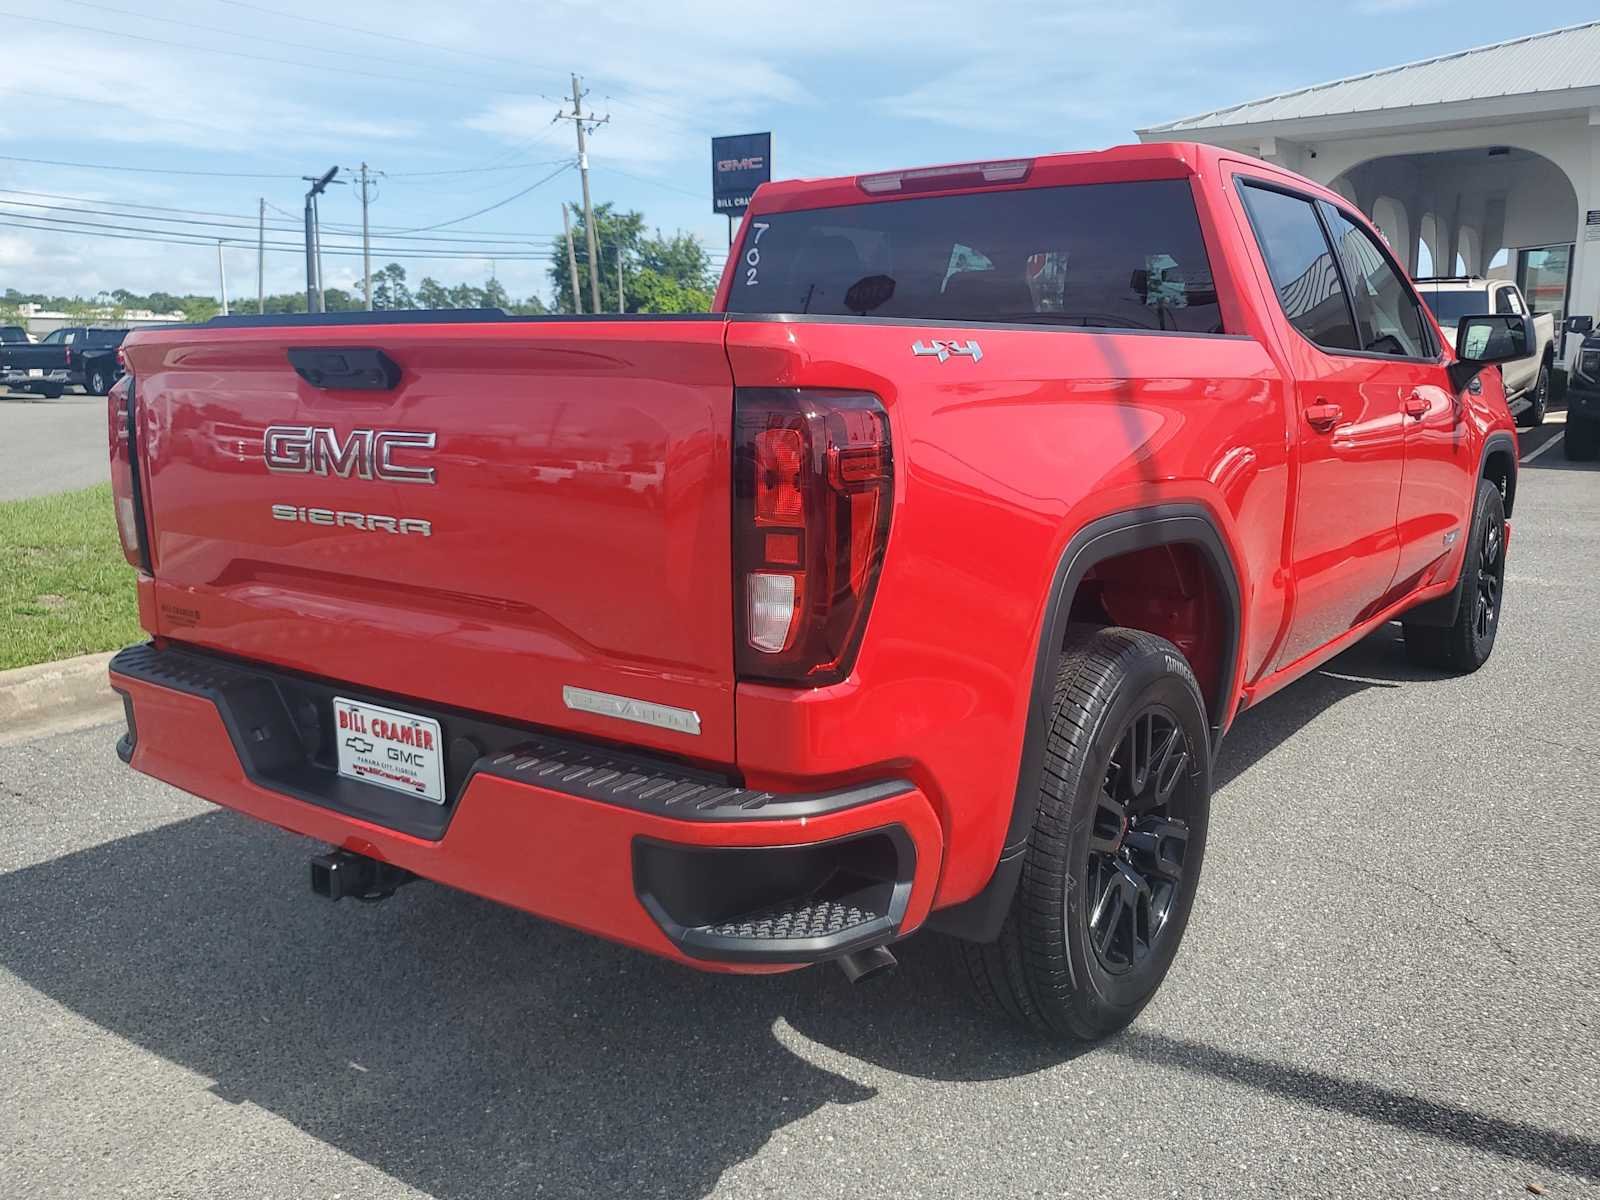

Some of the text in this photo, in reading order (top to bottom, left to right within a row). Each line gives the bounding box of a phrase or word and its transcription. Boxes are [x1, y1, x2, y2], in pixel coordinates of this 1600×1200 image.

[718, 157, 763, 171] GMC
[717, 198, 733, 208] BILL
[746, 223, 769, 285] 702
[264, 426, 436, 484] GMC
[272, 504, 432, 537] SIERRA
[339, 710, 434, 751] BILL CRAMER
[357, 756, 380, 767] PANAMA
[395, 765, 418, 777] FLORIDA
[388, 747, 424, 767] GMC
